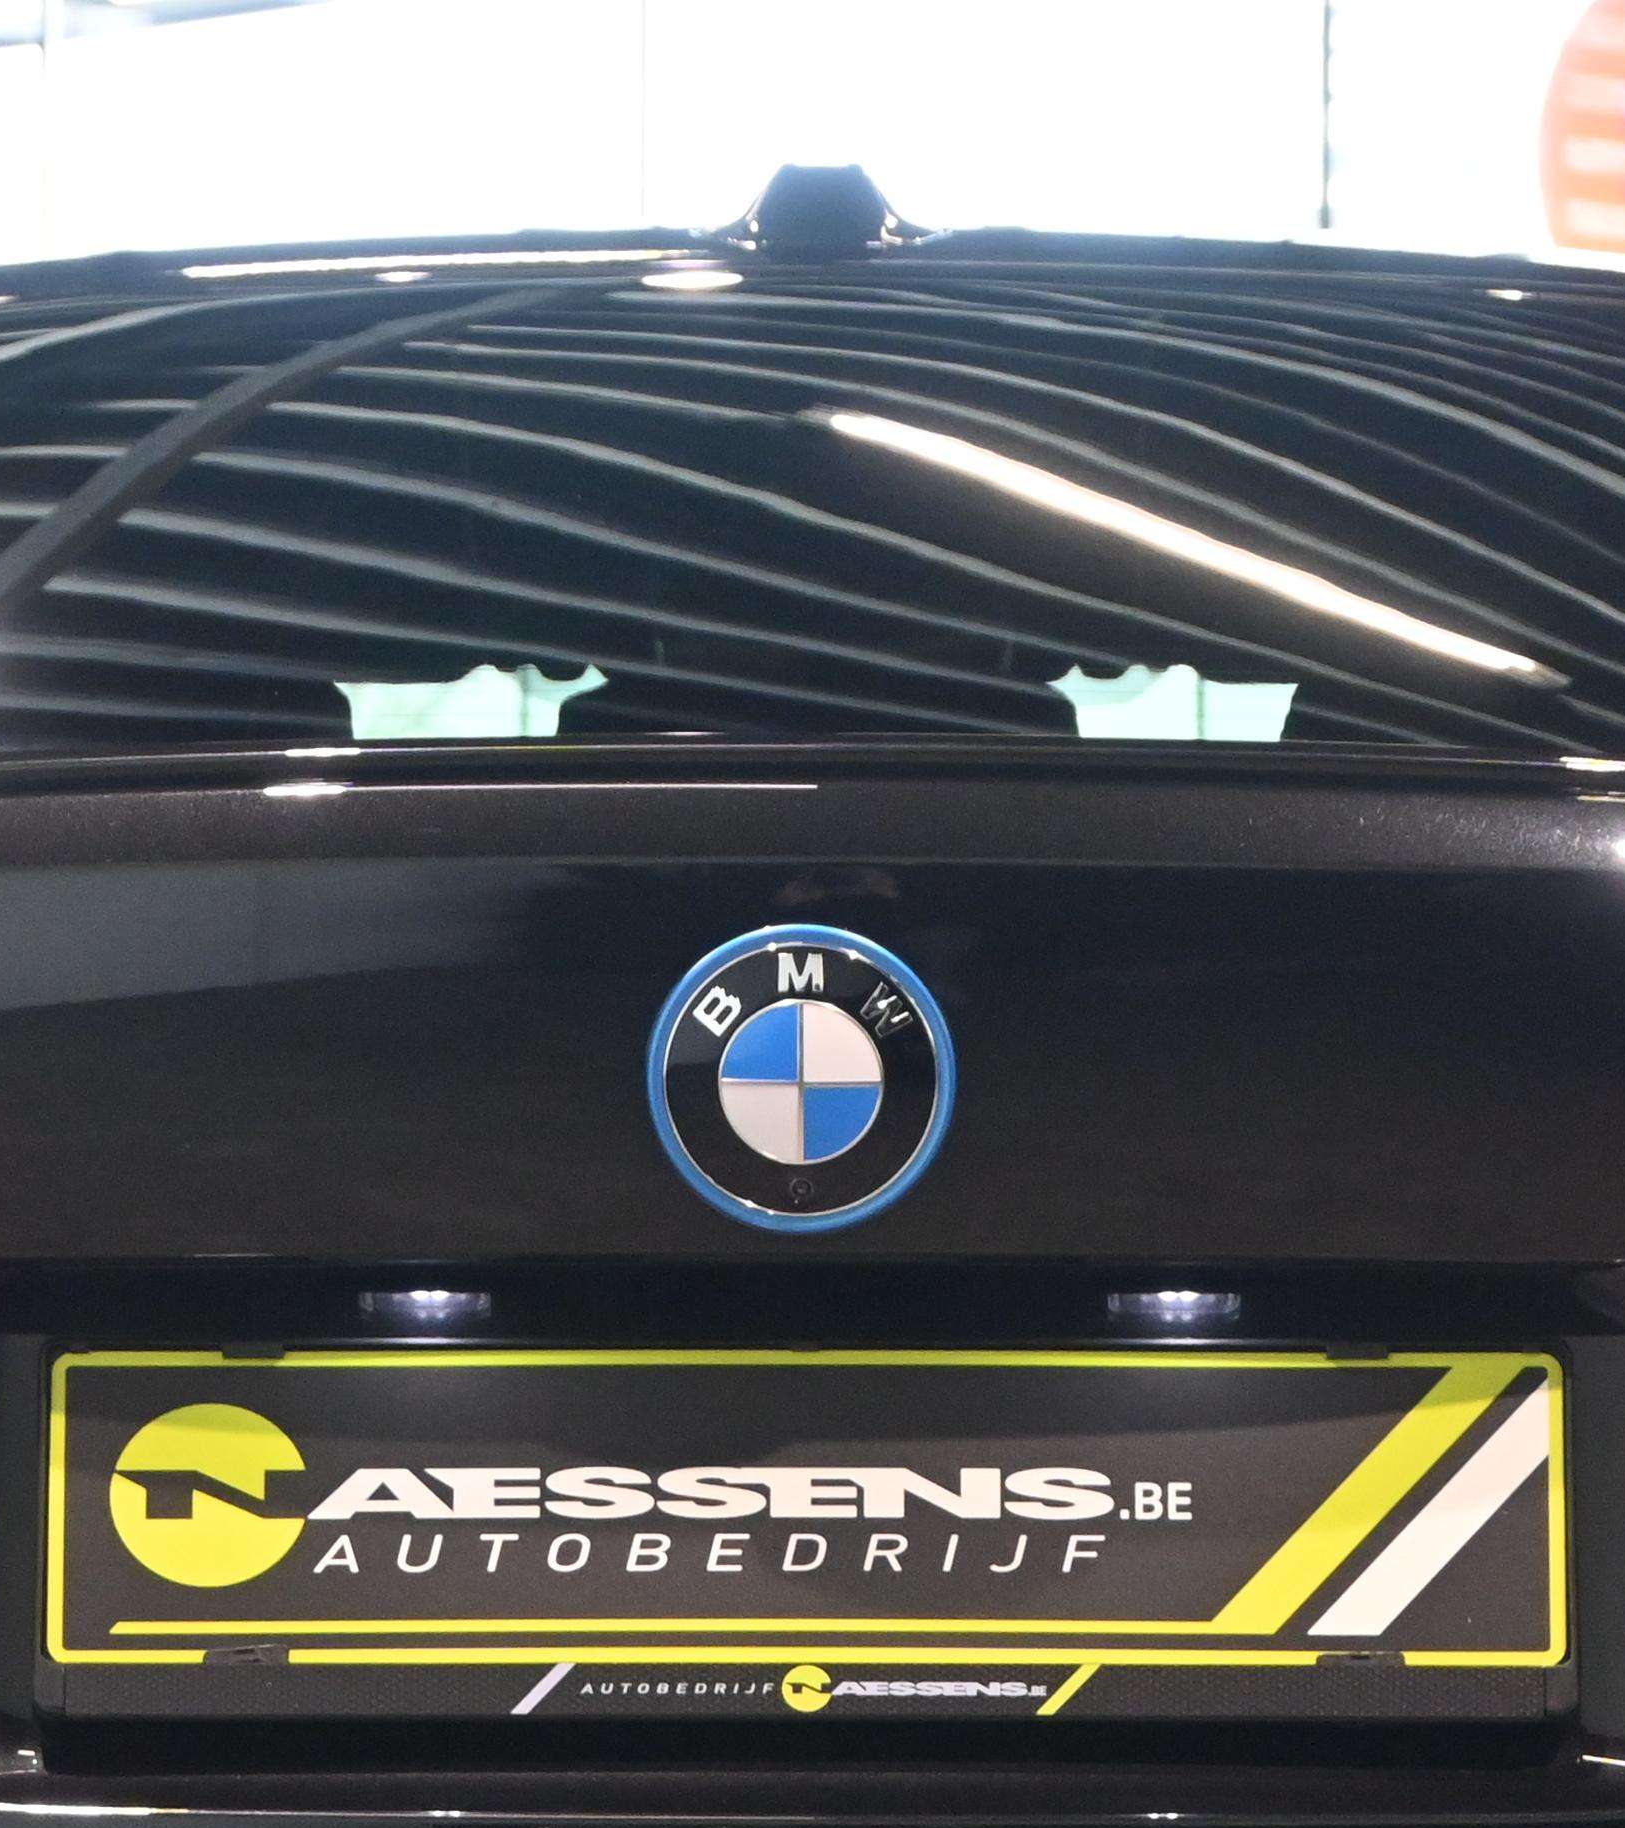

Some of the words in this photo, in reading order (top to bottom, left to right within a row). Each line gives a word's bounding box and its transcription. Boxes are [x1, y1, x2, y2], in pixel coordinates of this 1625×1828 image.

[692, 952, 914, 1038] BMW
[313, 1533, 1106, 1573] AUTOBEDRIJF
[580, 1682, 775, 1695] AUTOBEDRIJF
